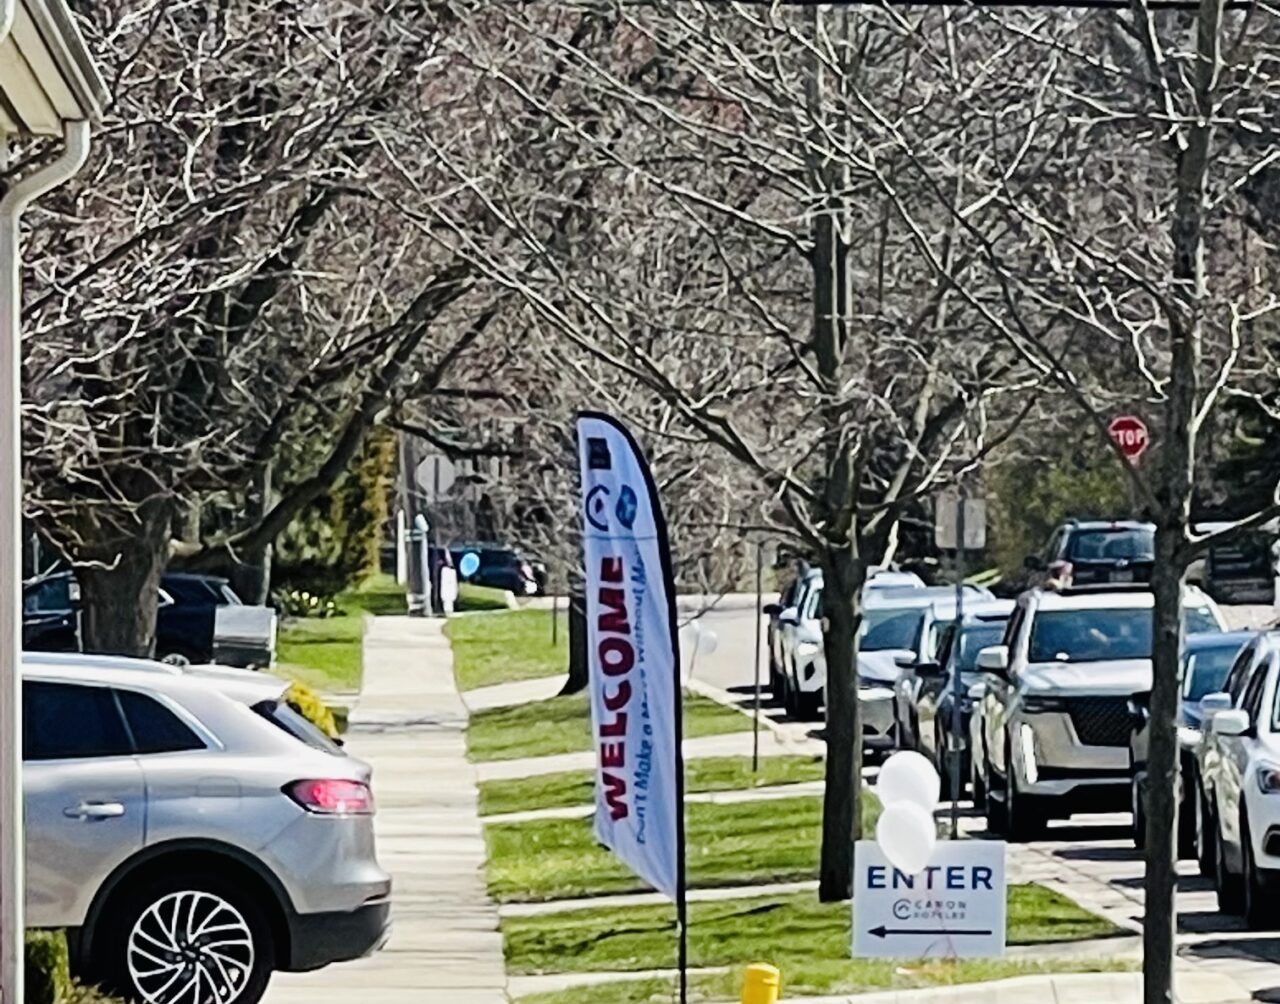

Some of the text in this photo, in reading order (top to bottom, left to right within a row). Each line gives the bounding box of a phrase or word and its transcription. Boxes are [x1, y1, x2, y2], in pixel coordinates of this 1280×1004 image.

[1109, 429, 1144, 445] TOP
[598, 556, 634, 821] WELCOME
[633, 740, 652, 790] Make
[867, 866, 993, 890] ENTER
